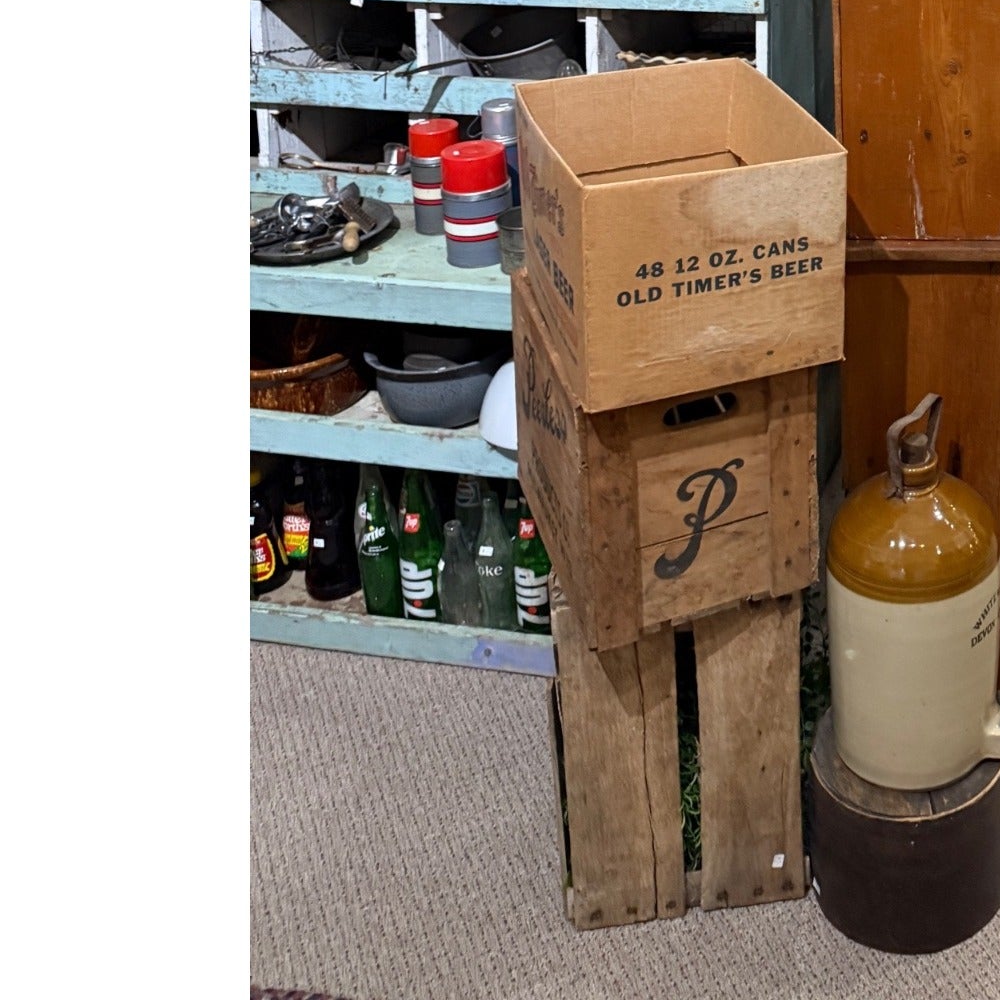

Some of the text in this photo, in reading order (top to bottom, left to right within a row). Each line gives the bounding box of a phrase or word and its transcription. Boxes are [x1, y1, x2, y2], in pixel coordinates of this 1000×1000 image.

[616, 256, 824, 308] OLD TIMER'S BEER
[635, 236, 810, 280] 48 12 OZ. CANS
[653, 457, 745, 580] P
